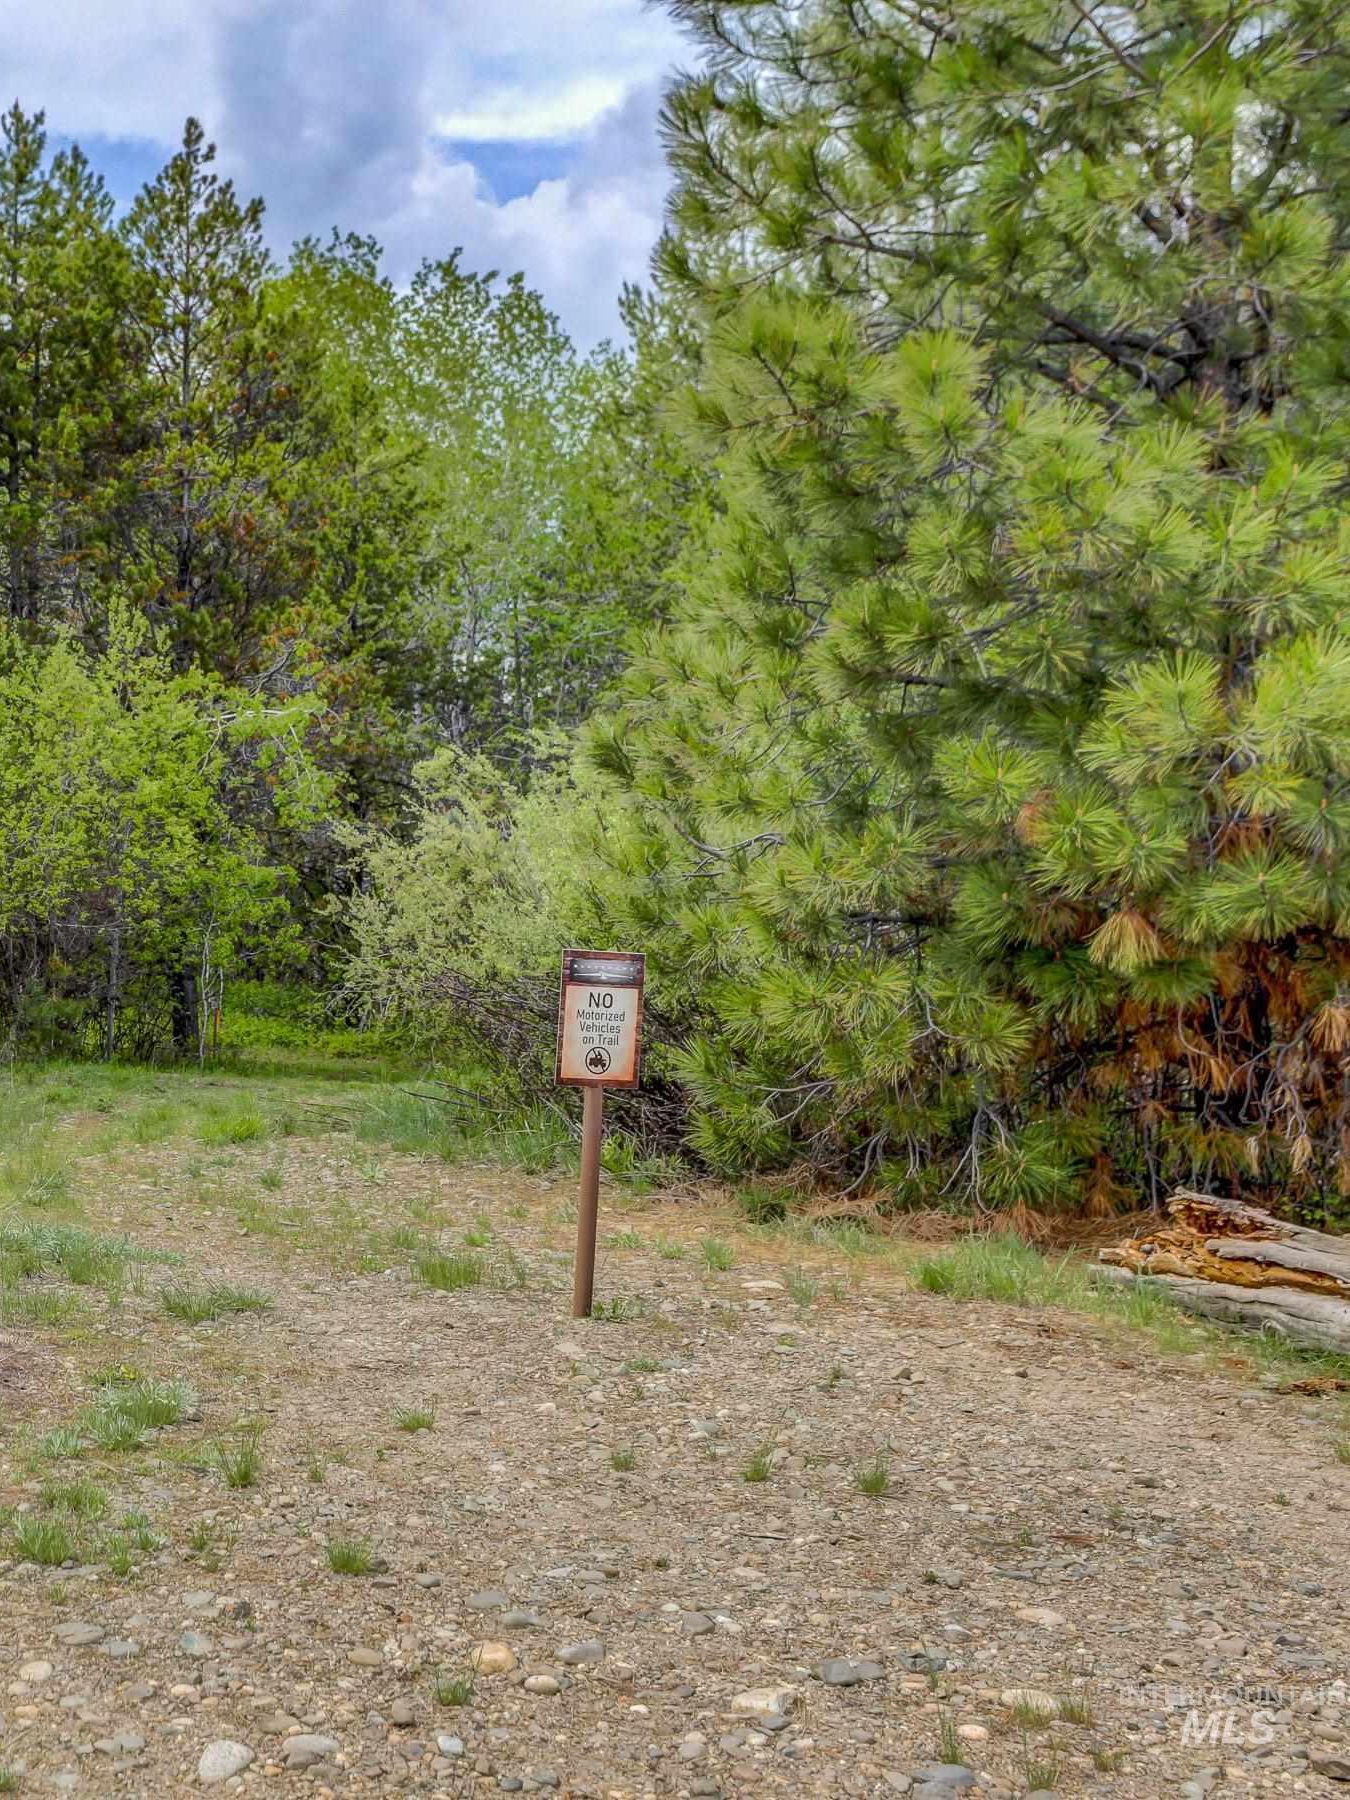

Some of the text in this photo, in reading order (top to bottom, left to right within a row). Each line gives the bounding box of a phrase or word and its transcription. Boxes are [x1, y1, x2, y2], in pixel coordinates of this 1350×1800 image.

[588, 992, 614, 1009] NO
[576, 1009, 625, 1022] Motorized
[579, 1021, 621, 1034] Vehicles
[582, 1034, 619, 1046] on Trail
